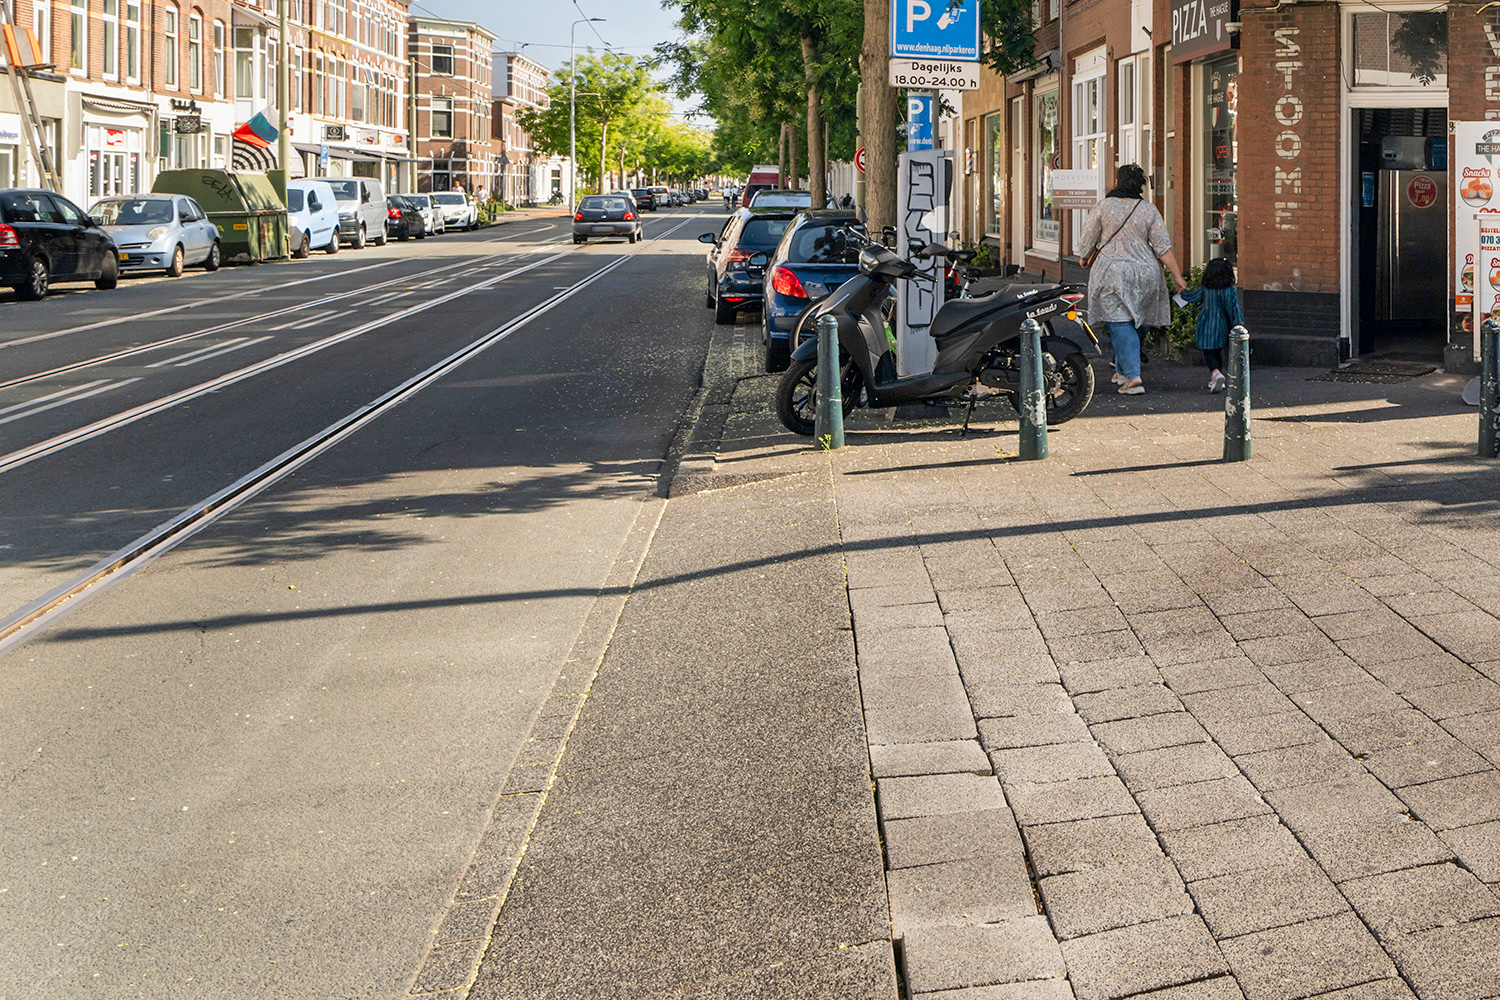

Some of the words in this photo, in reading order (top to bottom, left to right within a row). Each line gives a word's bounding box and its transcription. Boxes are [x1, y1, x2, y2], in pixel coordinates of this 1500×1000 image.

[906, 0, 932, 32] P
[897, 42, 976, 55] www.denhaag.nl/parkeren
[912, 62, 962, 74] Dagelijks
[895, 75, 966, 87] 18.00-24.00
[970, 80, 976, 88] h
[908, 99, 924, 122] P
[1463, 167, 1490, 178] Snacks
[1414, 182, 1432, 190] Pizza
[1481, 236, 1494, 244] 070
